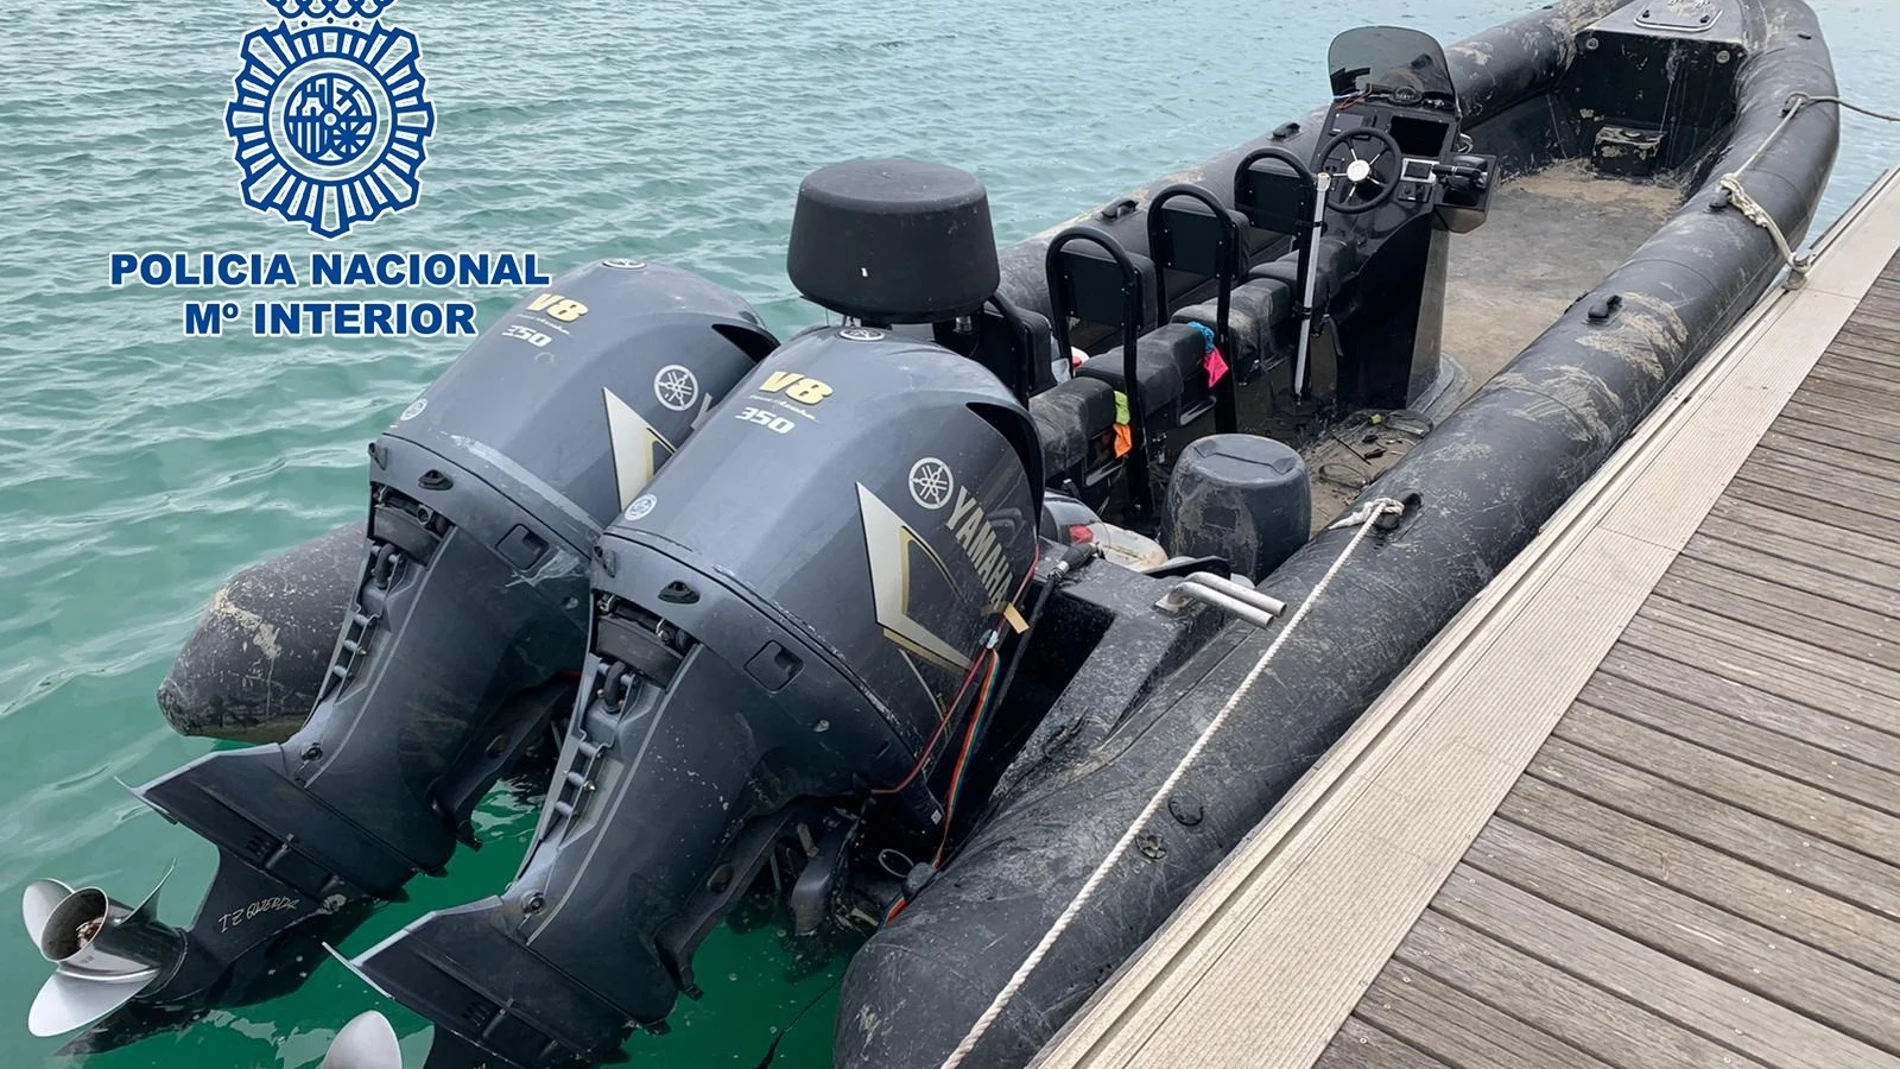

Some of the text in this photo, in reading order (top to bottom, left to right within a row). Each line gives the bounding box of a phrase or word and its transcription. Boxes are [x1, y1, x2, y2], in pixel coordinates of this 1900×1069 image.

[525, 292, 590, 323] V8
[501, 324, 553, 348] 350
[758, 370, 834, 406] V8
[735, 406, 796, 434] 350
[946, 484, 1014, 612] YAMAHA
